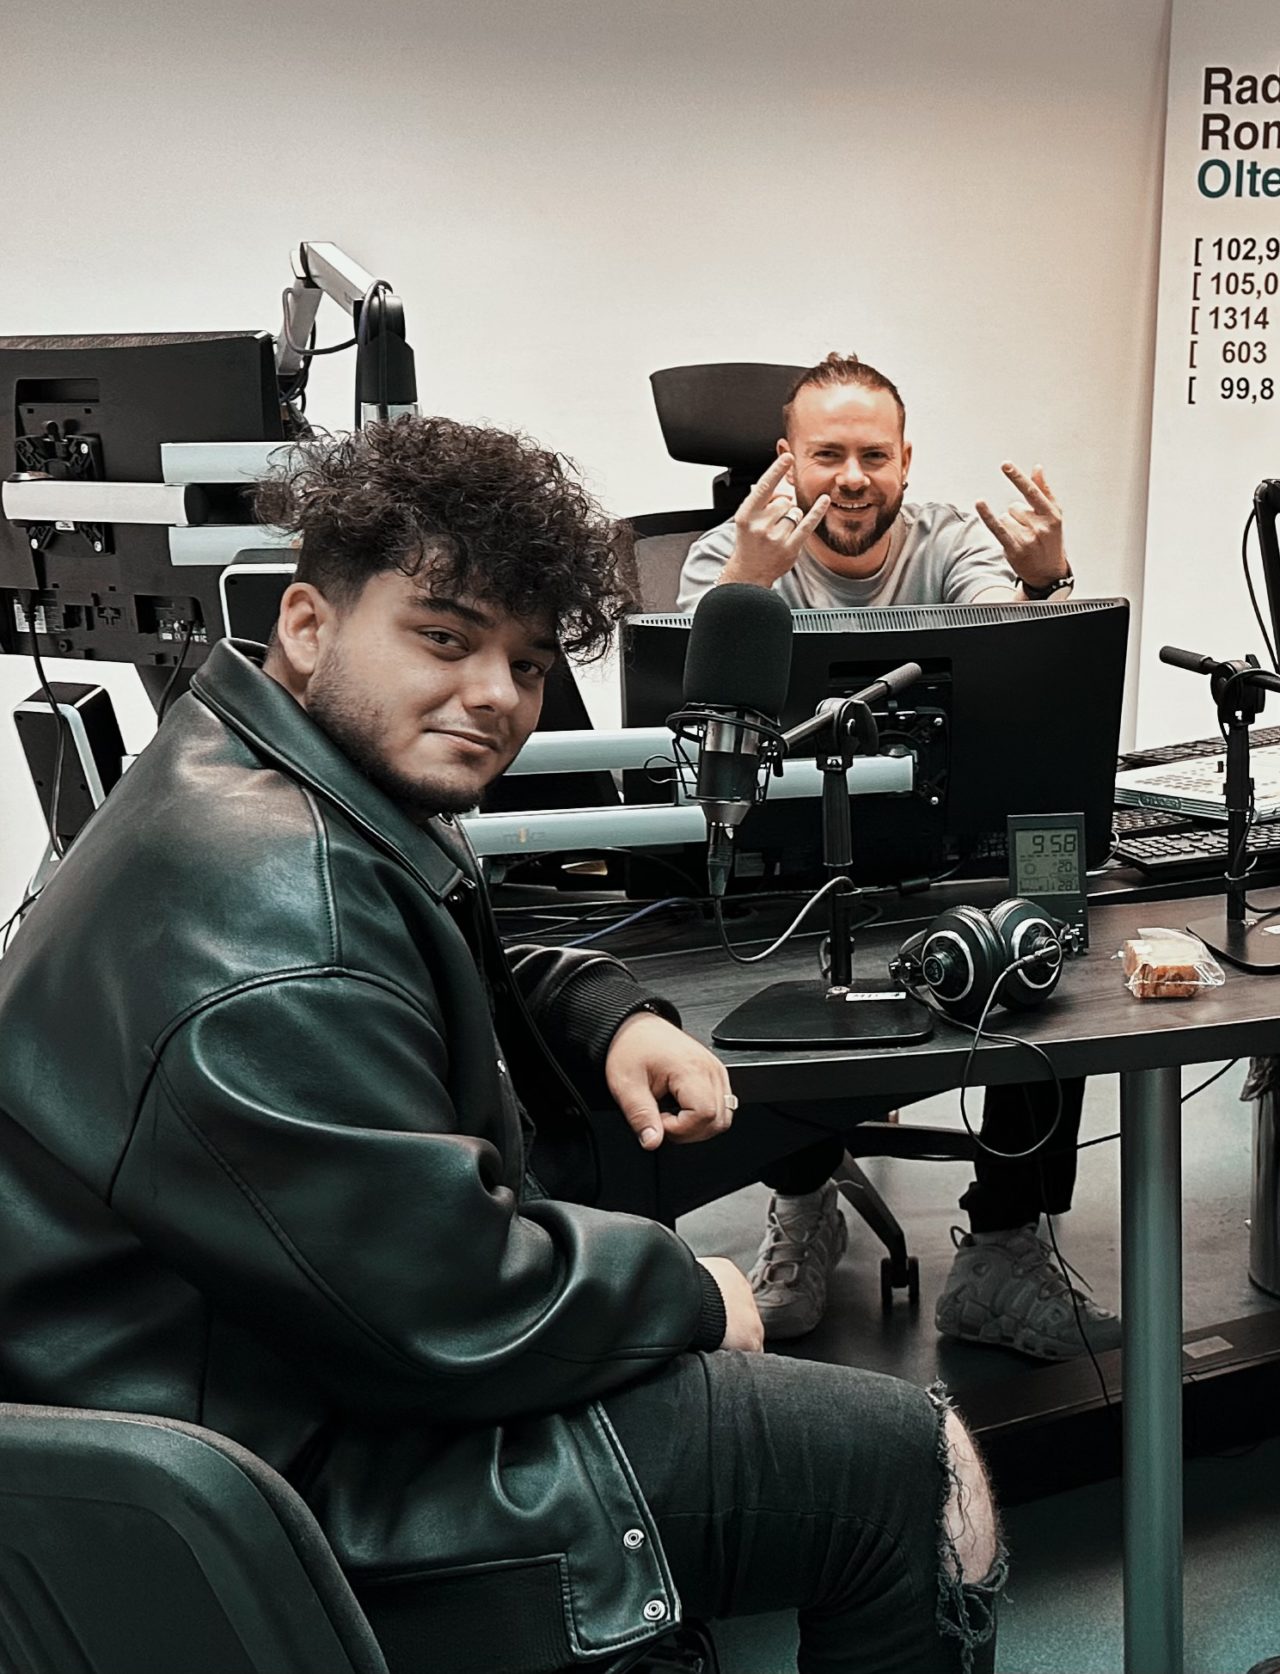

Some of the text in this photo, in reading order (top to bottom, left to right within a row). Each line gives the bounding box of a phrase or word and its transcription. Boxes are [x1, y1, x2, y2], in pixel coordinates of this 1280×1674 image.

[1212, 237, 1280, 265] 102,9
[1210, 272, 1279, 300] 105,0
[1208, 306, 1270, 330] 1314
[1222, 340, 1267, 365] 603
[1220, 376, 1274, 404] 99,8
